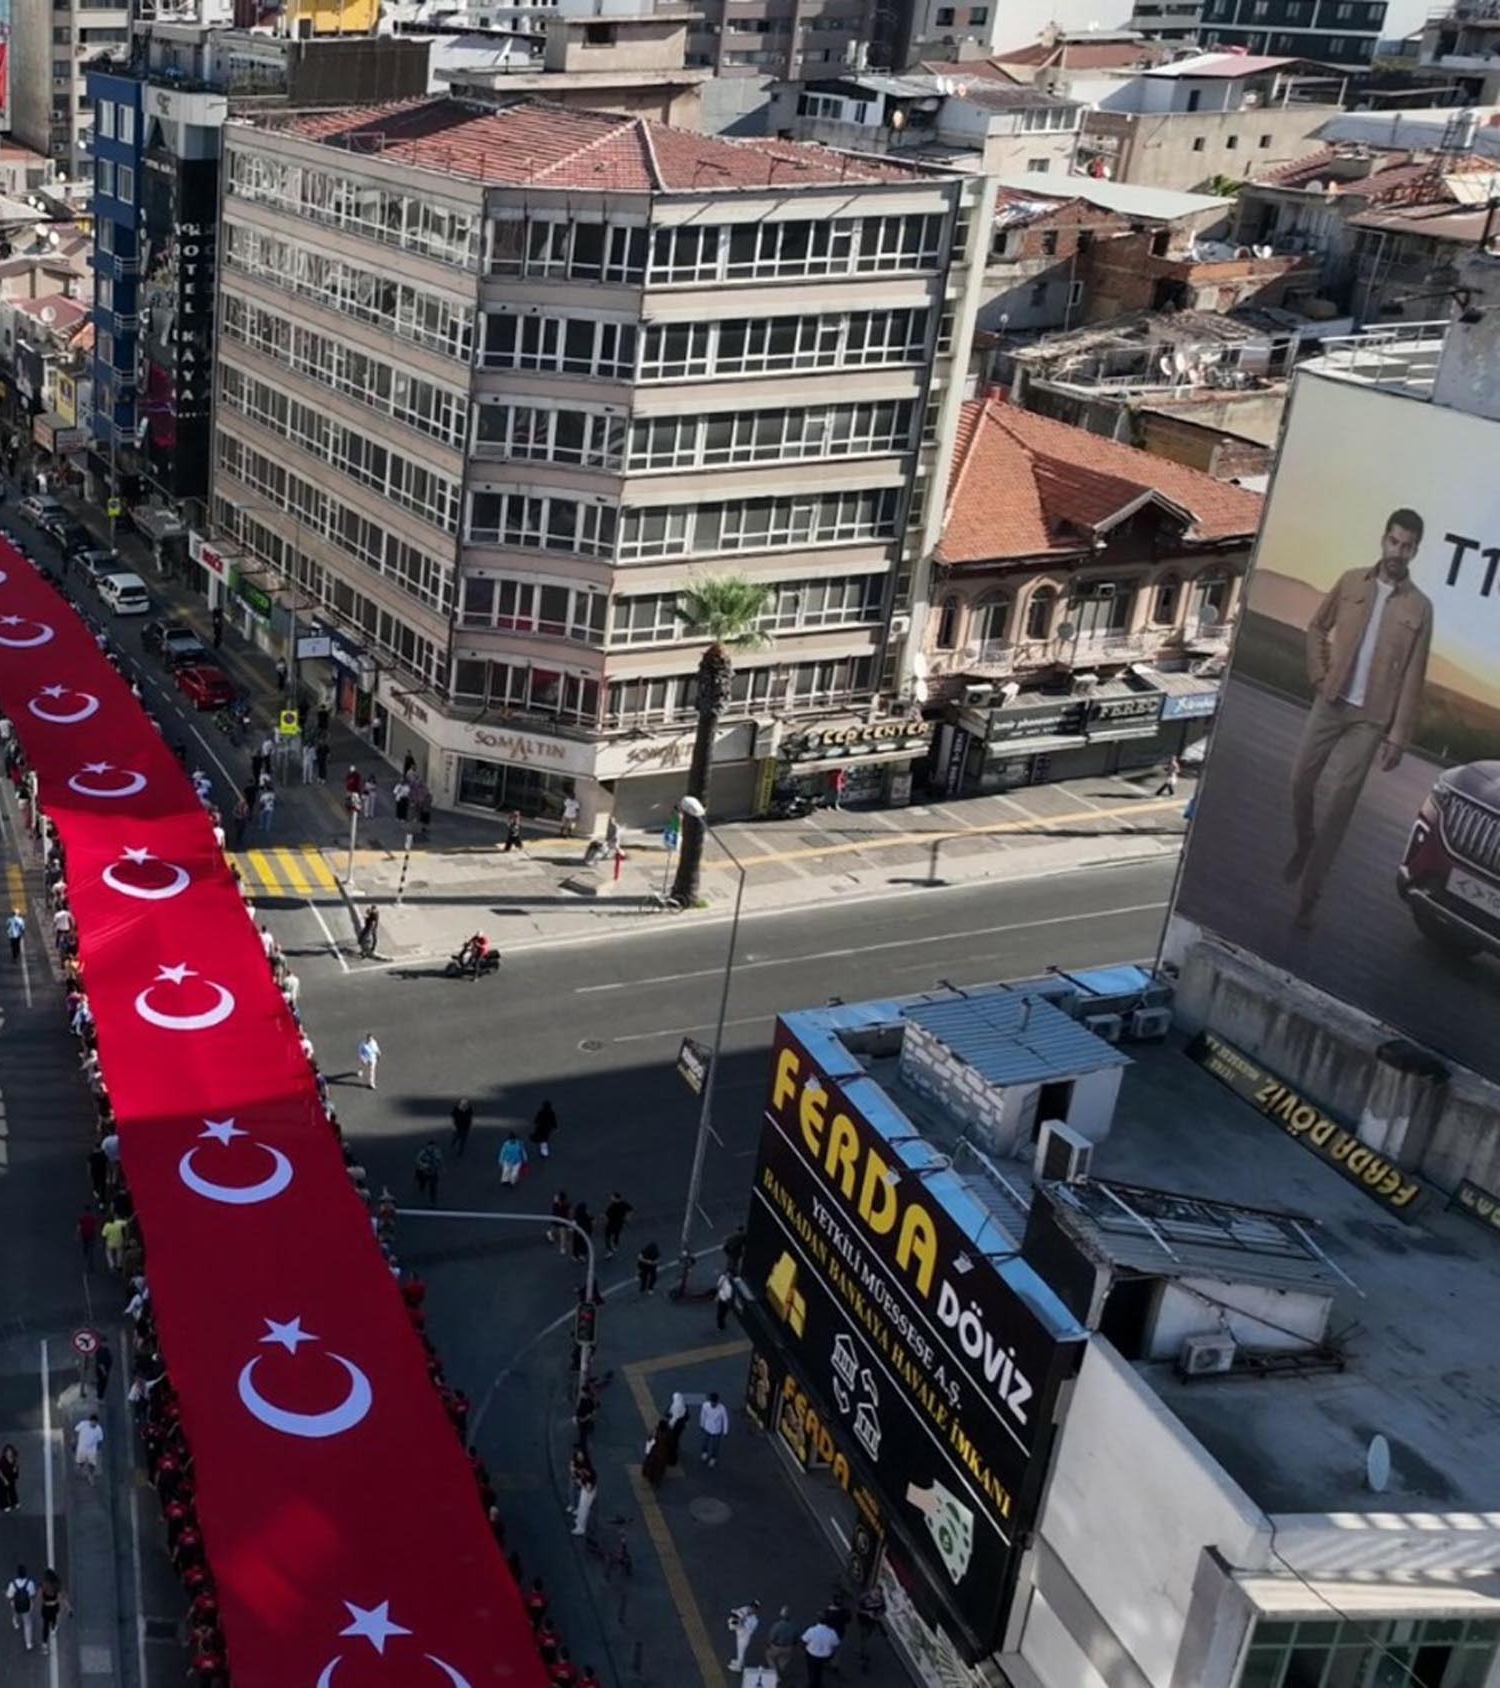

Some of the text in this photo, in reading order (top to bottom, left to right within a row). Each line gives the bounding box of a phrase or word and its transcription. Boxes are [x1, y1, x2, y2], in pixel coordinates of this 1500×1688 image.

[183, 244, 200, 314] OTEL
[180, 330, 196, 401] KAYA
[474, 730, 567, 761] SOMALTIN
[861, 722, 929, 741] CENTER
[1254, 1076, 1419, 1207] FERDA DÖVİZ
[772, 1047, 1034, 1426] FERDA DÖVİZ
[812, 1195, 862, 1273] YETKİLİ
[860, 1262, 934, 1370] MÜESSESE
[763, 1167, 1012, 1519] BANKADAN BANKAYA HAVALE İMKANI
[782, 1375, 850, 1492] FERDA
